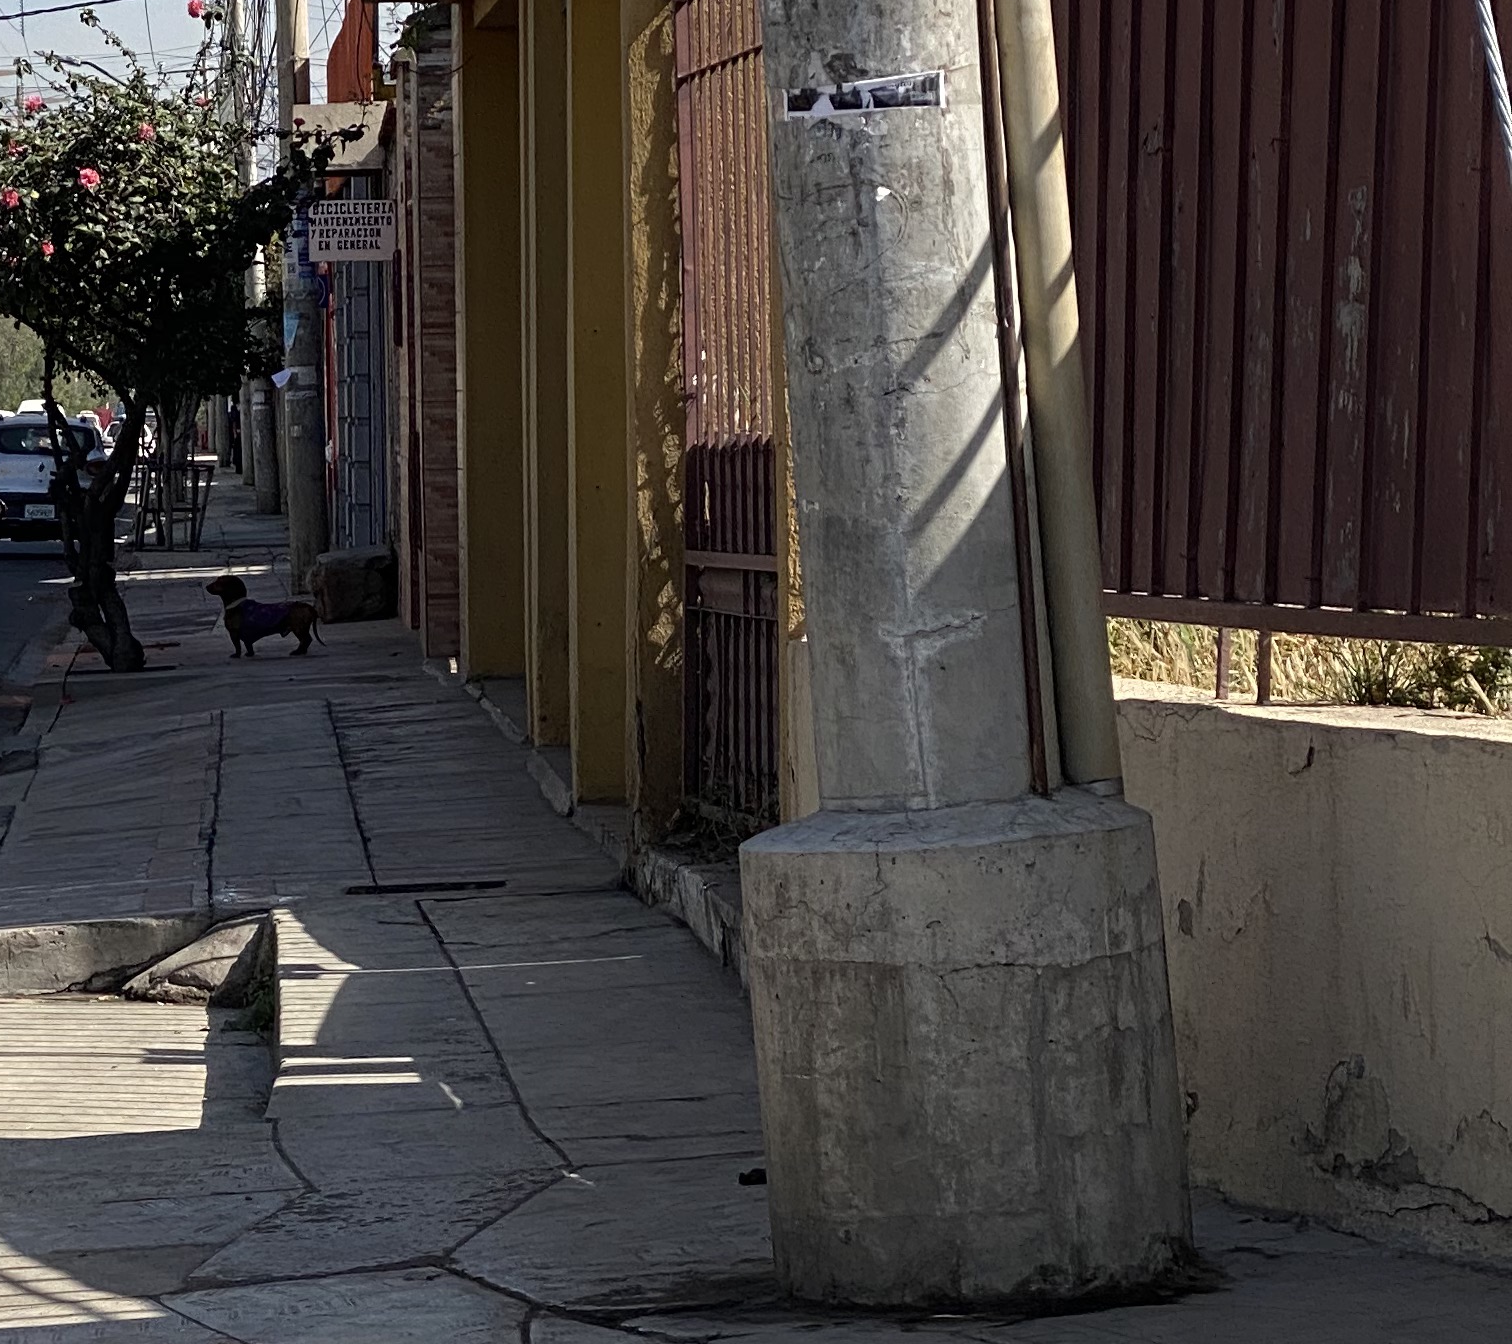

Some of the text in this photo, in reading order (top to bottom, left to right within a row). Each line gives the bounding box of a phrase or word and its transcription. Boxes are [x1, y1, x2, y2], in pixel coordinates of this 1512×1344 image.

[312, 201, 394, 215] BICICLETERIA
[310, 216, 393, 227] MANTENIMIENTO
[310, 227, 382, 239] Y REPARACION
[318, 239, 381, 251] EN GENERAL
